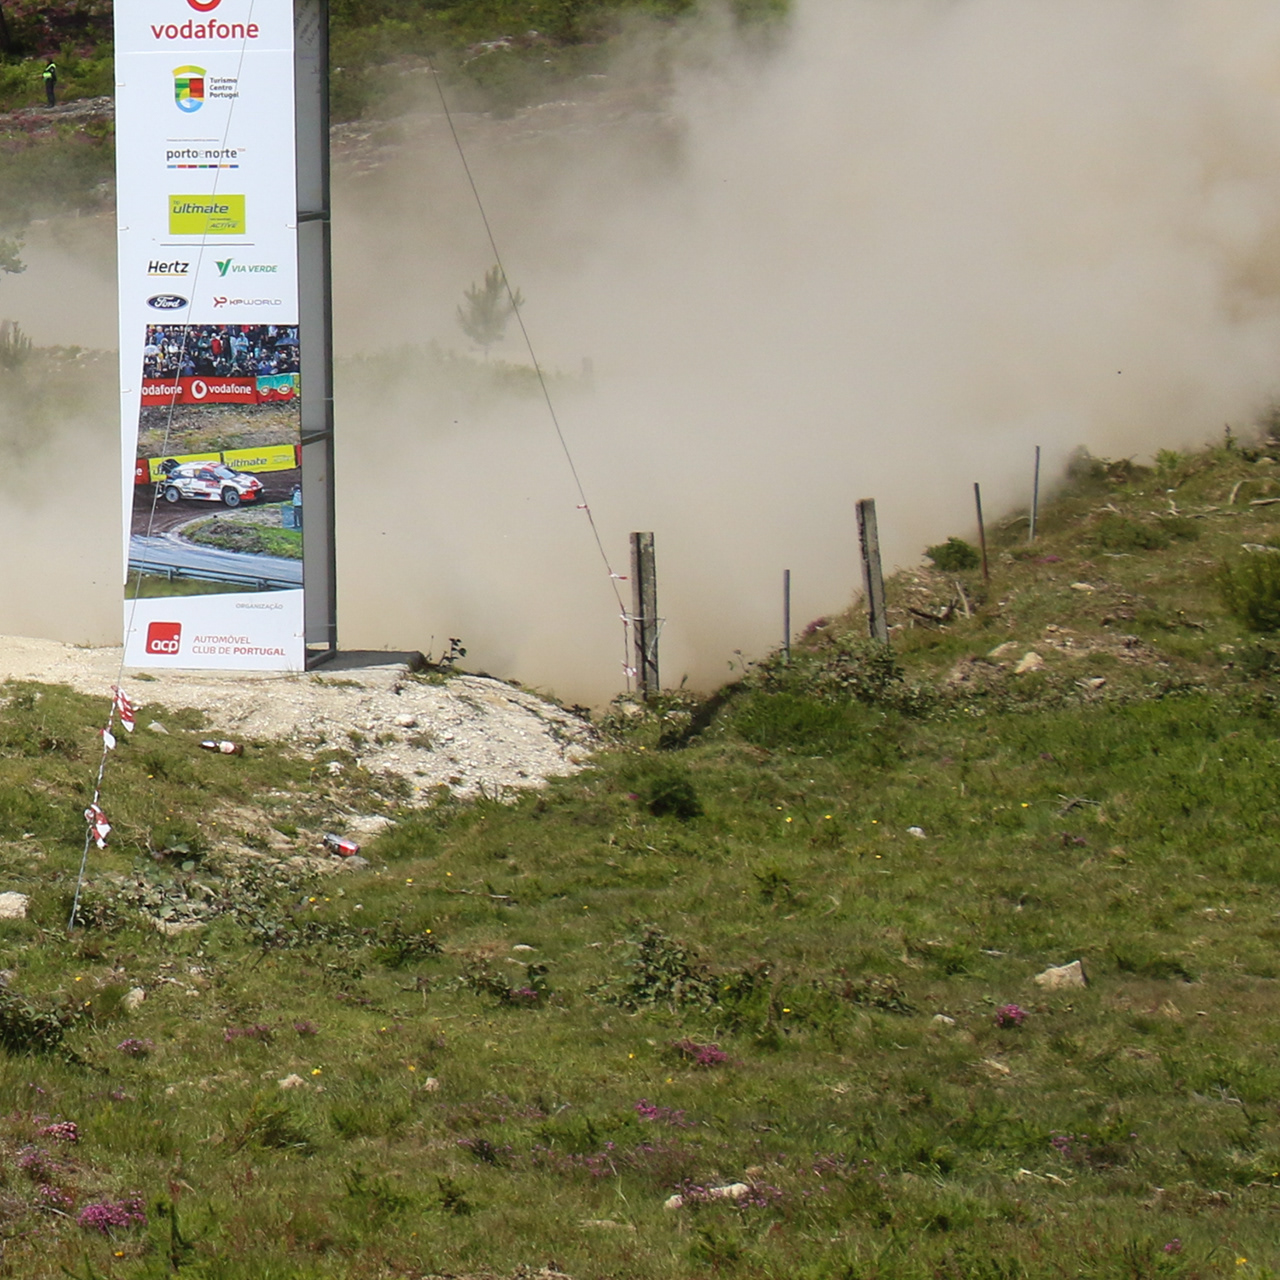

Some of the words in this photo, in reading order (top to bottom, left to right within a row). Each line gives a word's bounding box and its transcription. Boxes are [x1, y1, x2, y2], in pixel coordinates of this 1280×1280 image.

[151, 19, 260, 40] vodafone
[210, 91, 239, 100] Portugal
[173, 202, 229, 214] ultimate
[147, 260, 189, 274] Hertz
[231, 265, 247, 273] VIA
[248, 265, 278, 273] VERDE
[153, 296, 181, 308] Ford
[141, 384, 183, 396] odafone
[209, 384, 252, 395] vodafone
[151, 639, 179, 653] acp
[192, 646, 216, 655] CLUB
[218, 647, 231, 655] DE
[233, 647, 287, 656] PORTUGAL
